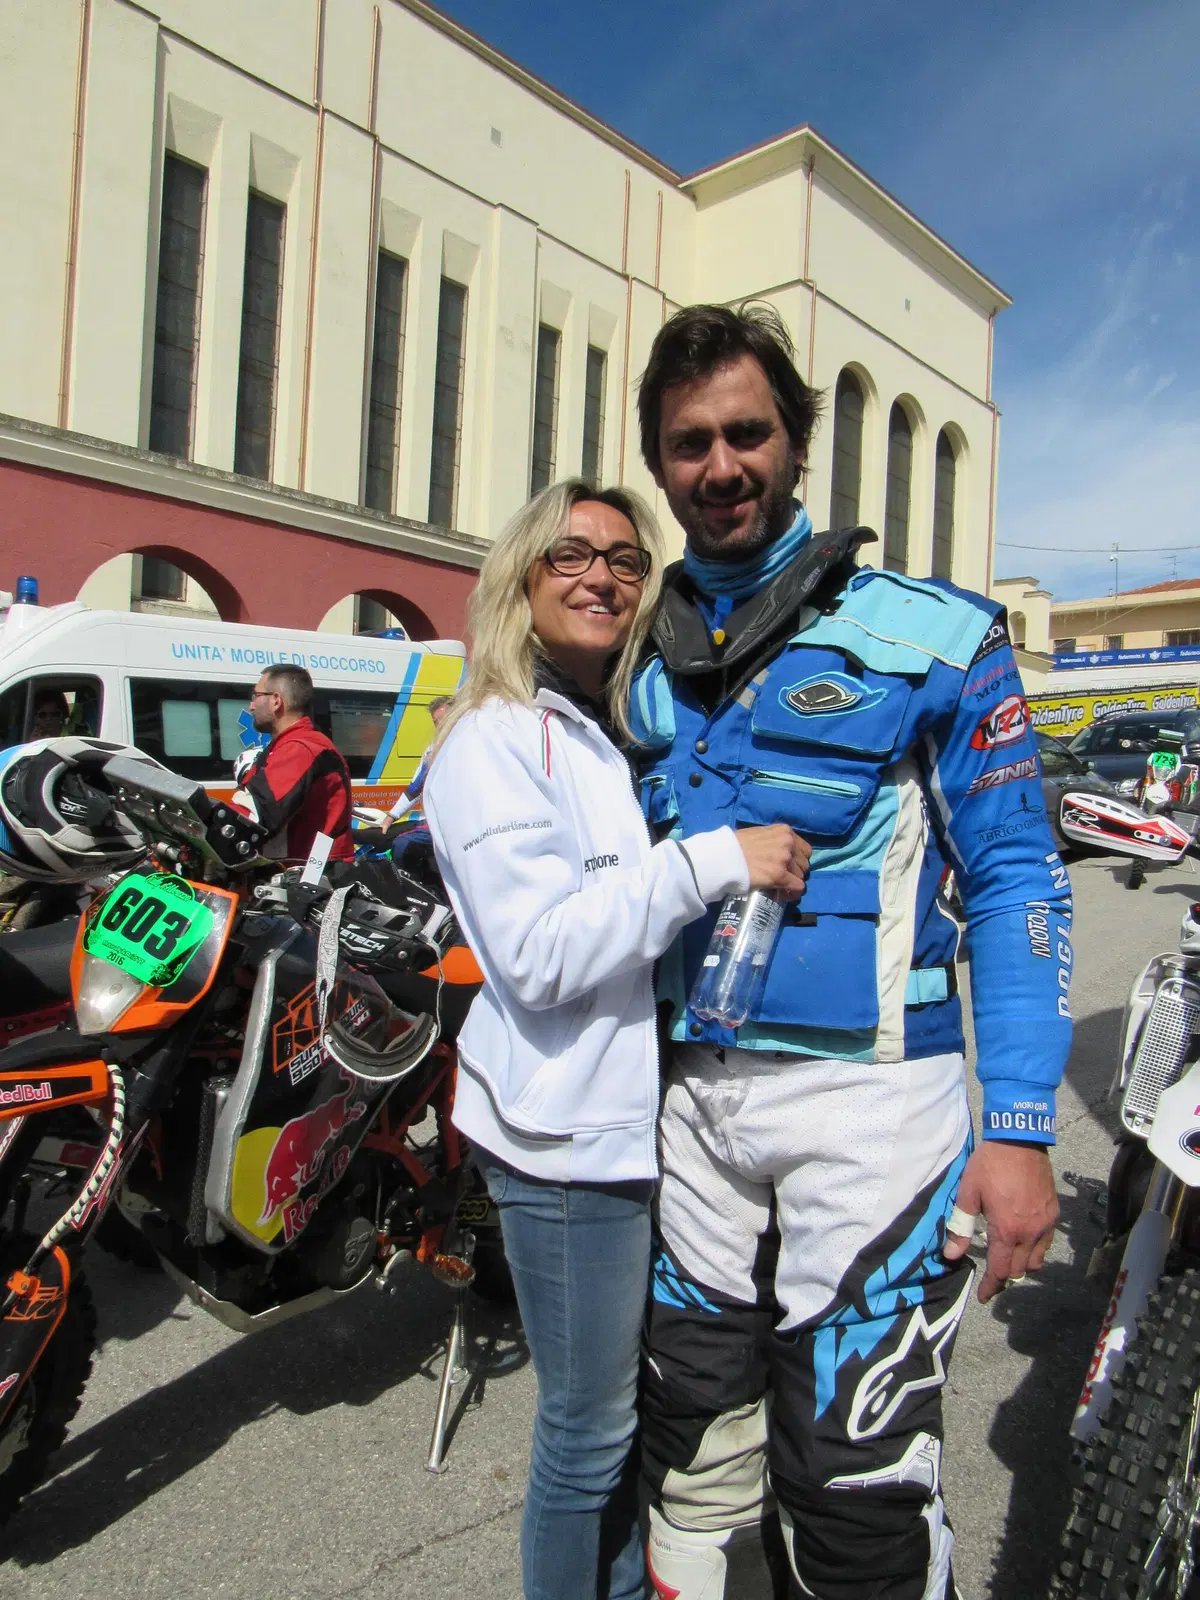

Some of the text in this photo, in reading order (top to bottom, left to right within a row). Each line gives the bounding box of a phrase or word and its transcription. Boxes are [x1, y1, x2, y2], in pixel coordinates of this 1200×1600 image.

[171, 643, 386, 674] UNITA' MOBILE DI SOCCORSO
[1028, 704, 1084, 727] oldenTyre
[463, 819, 553, 852] www.cellularline.com
[101, 887, 193, 961] 603
[106, 951, 126, 966] 2016
[23, 1081, 52, 1100] Bull
